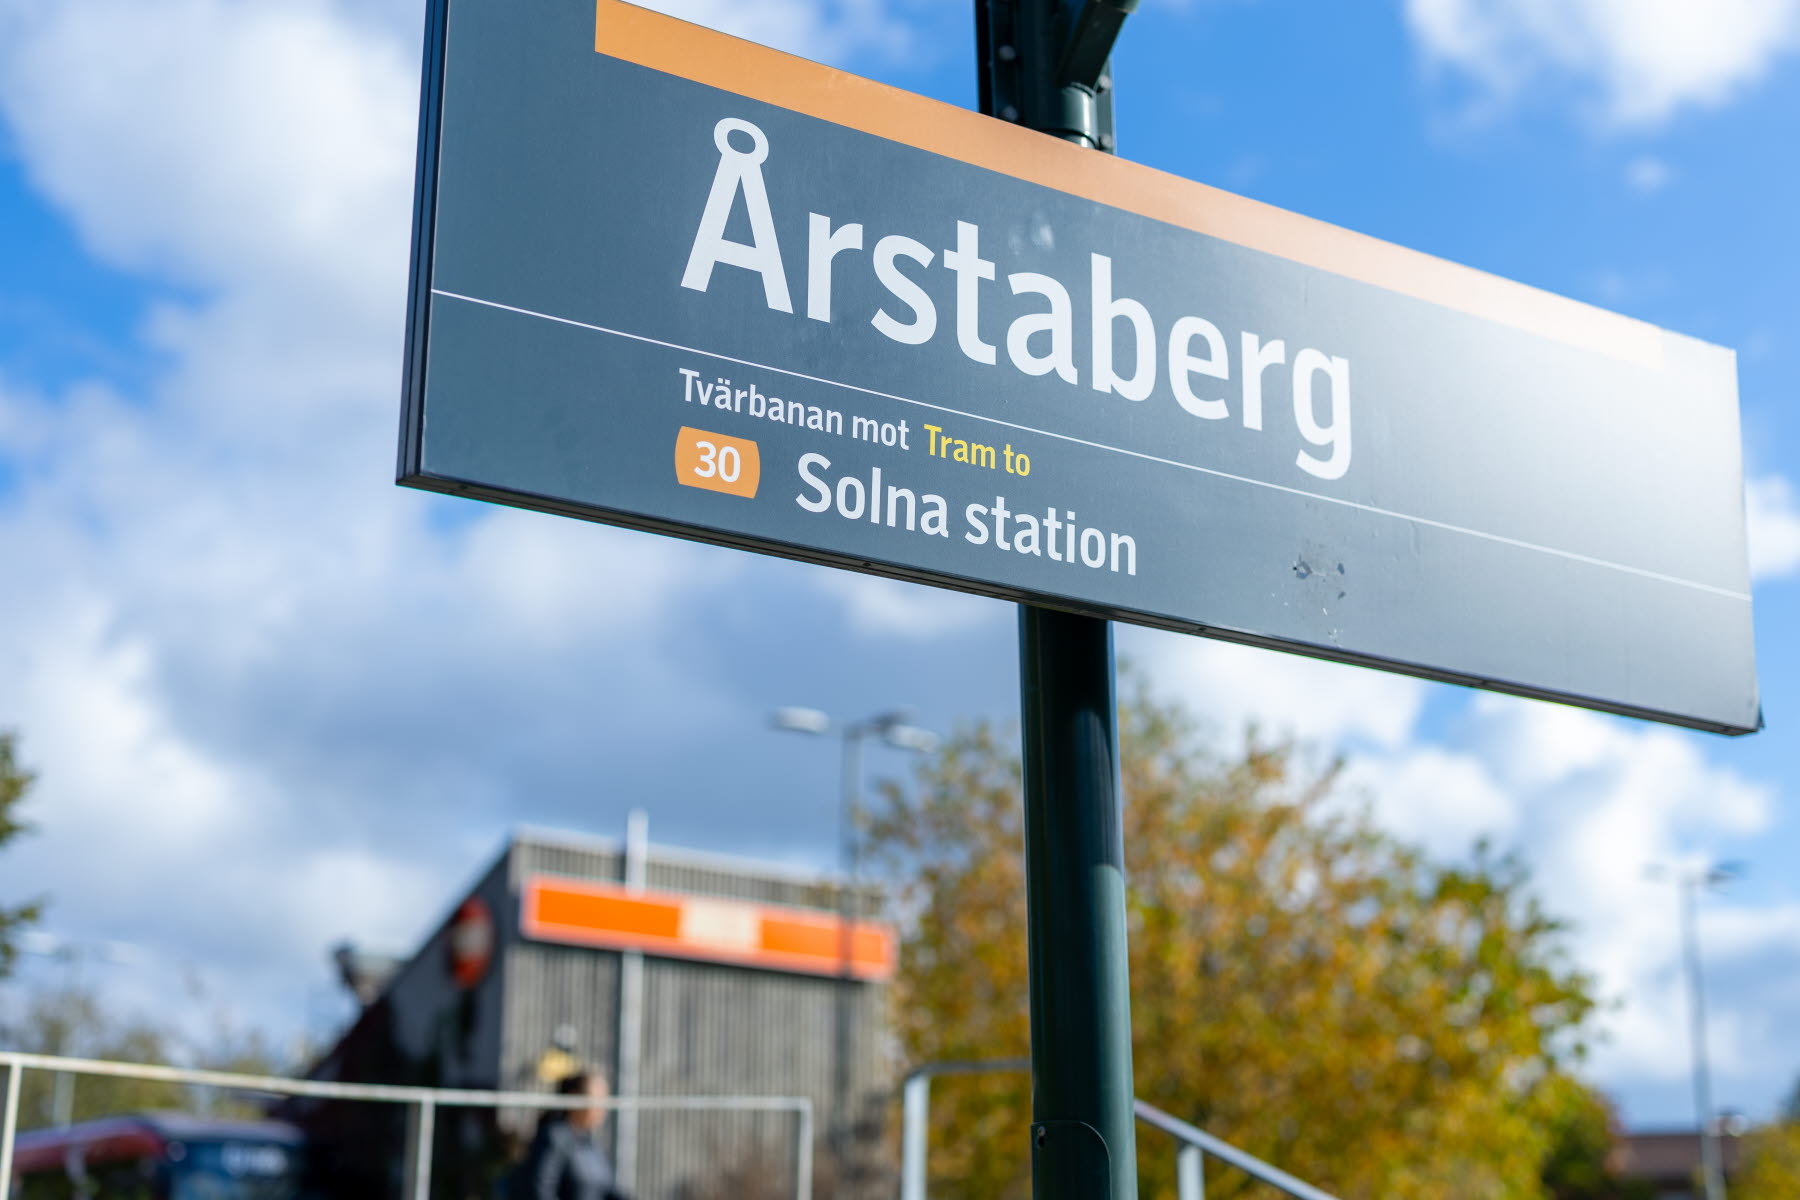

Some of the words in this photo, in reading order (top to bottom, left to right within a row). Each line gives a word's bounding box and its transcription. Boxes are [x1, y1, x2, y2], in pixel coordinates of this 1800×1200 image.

[680, 117, 1353, 480] Årstaberg
[678, 367, 843, 435] Tvärbanan
[852, 415, 910, 450] mot
[923, 423, 996, 469] Tram
[1003, 444, 1031, 477] to
[694, 440, 742, 484] 30
[795, 452, 949, 539] Solna
[964, 495, 1137, 576] station
